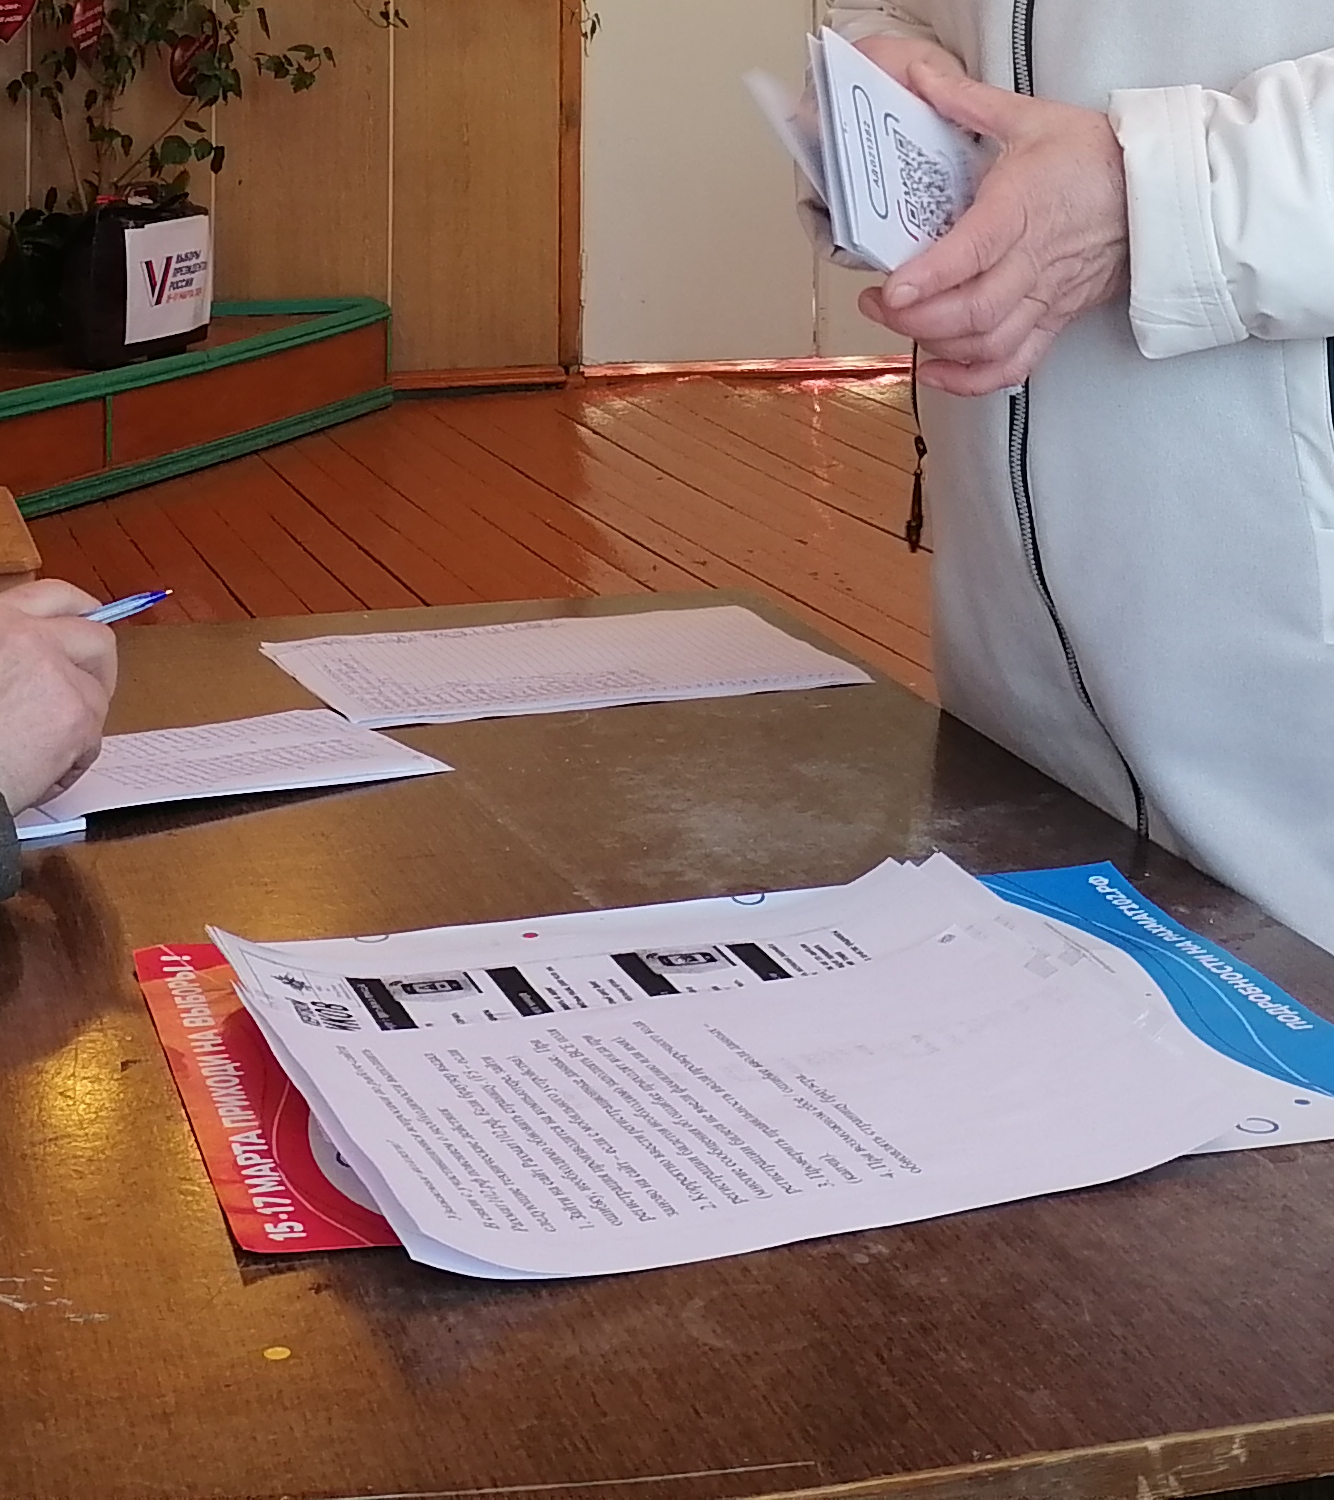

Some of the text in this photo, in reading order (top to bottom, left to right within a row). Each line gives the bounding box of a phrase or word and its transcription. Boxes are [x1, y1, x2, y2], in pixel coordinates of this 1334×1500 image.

[1087, 874, 1186, 943] РАХМАТ102.РФ
[1193, 948, 1314, 1031] ПОДРОБНОСТИ
[186, 1029, 225, 1053] НА
[445, 1048, 469, 1064] если
[528, 1038, 558, 1054] При
[555, 1042, 585, 1059] ВСЕ
[626, 1050, 653, 1064] или
[479, 1055, 507, 1075] зайти
[195, 1054, 259, 1128] ПРИХОДИ
[436, 1072, 478, 1099] браузер
[460, 1098, 491, 1116] Если
[542, 1092, 597, 1133] мобильного
[572, 1077, 645, 1134] регистрационные
[612, 1086, 663, 1128] необходимо
[640, 1091, 687, 1119] ошибке
[718, 1092, 780, 1138] правильность
[791, 1096, 819, 1112] сбое
[825, 1102, 883, 1136] страницу
[545, 1124, 610, 1173] производится
[586, 1136, 618, 1154] если
[628, 1133, 668, 1159] ввести
[648, 1127, 694, 1156] билетов
[680, 1127, 741, 1168] сообщения
[811, 1110, 874, 1153] возможном
[230, 1129, 282, 1193] МАРТА
[537, 1146, 592, 1192] необходимо
[611, 1160, 645, 1179] сайт
[732, 1145, 805, 1194] регистрации
[768, 1137, 833, 1179] Проверить
[852, 1151, 895, 1170] При
[524, 1167, 558, 1187] сайт
[650, 1158, 714, 1202] Корректно
[680, 1155, 752, 1204] регистрации
[723, 1167, 776, 1200] (многие
[550, 1195, 589, 1221] Зайти
[577, 1190, 626, 1226] ошибку,
[593, 1172, 659, 1222] регистрация
[639, 1188, 679, 1217] заново
[251, 1197, 307, 1241] 15-17
